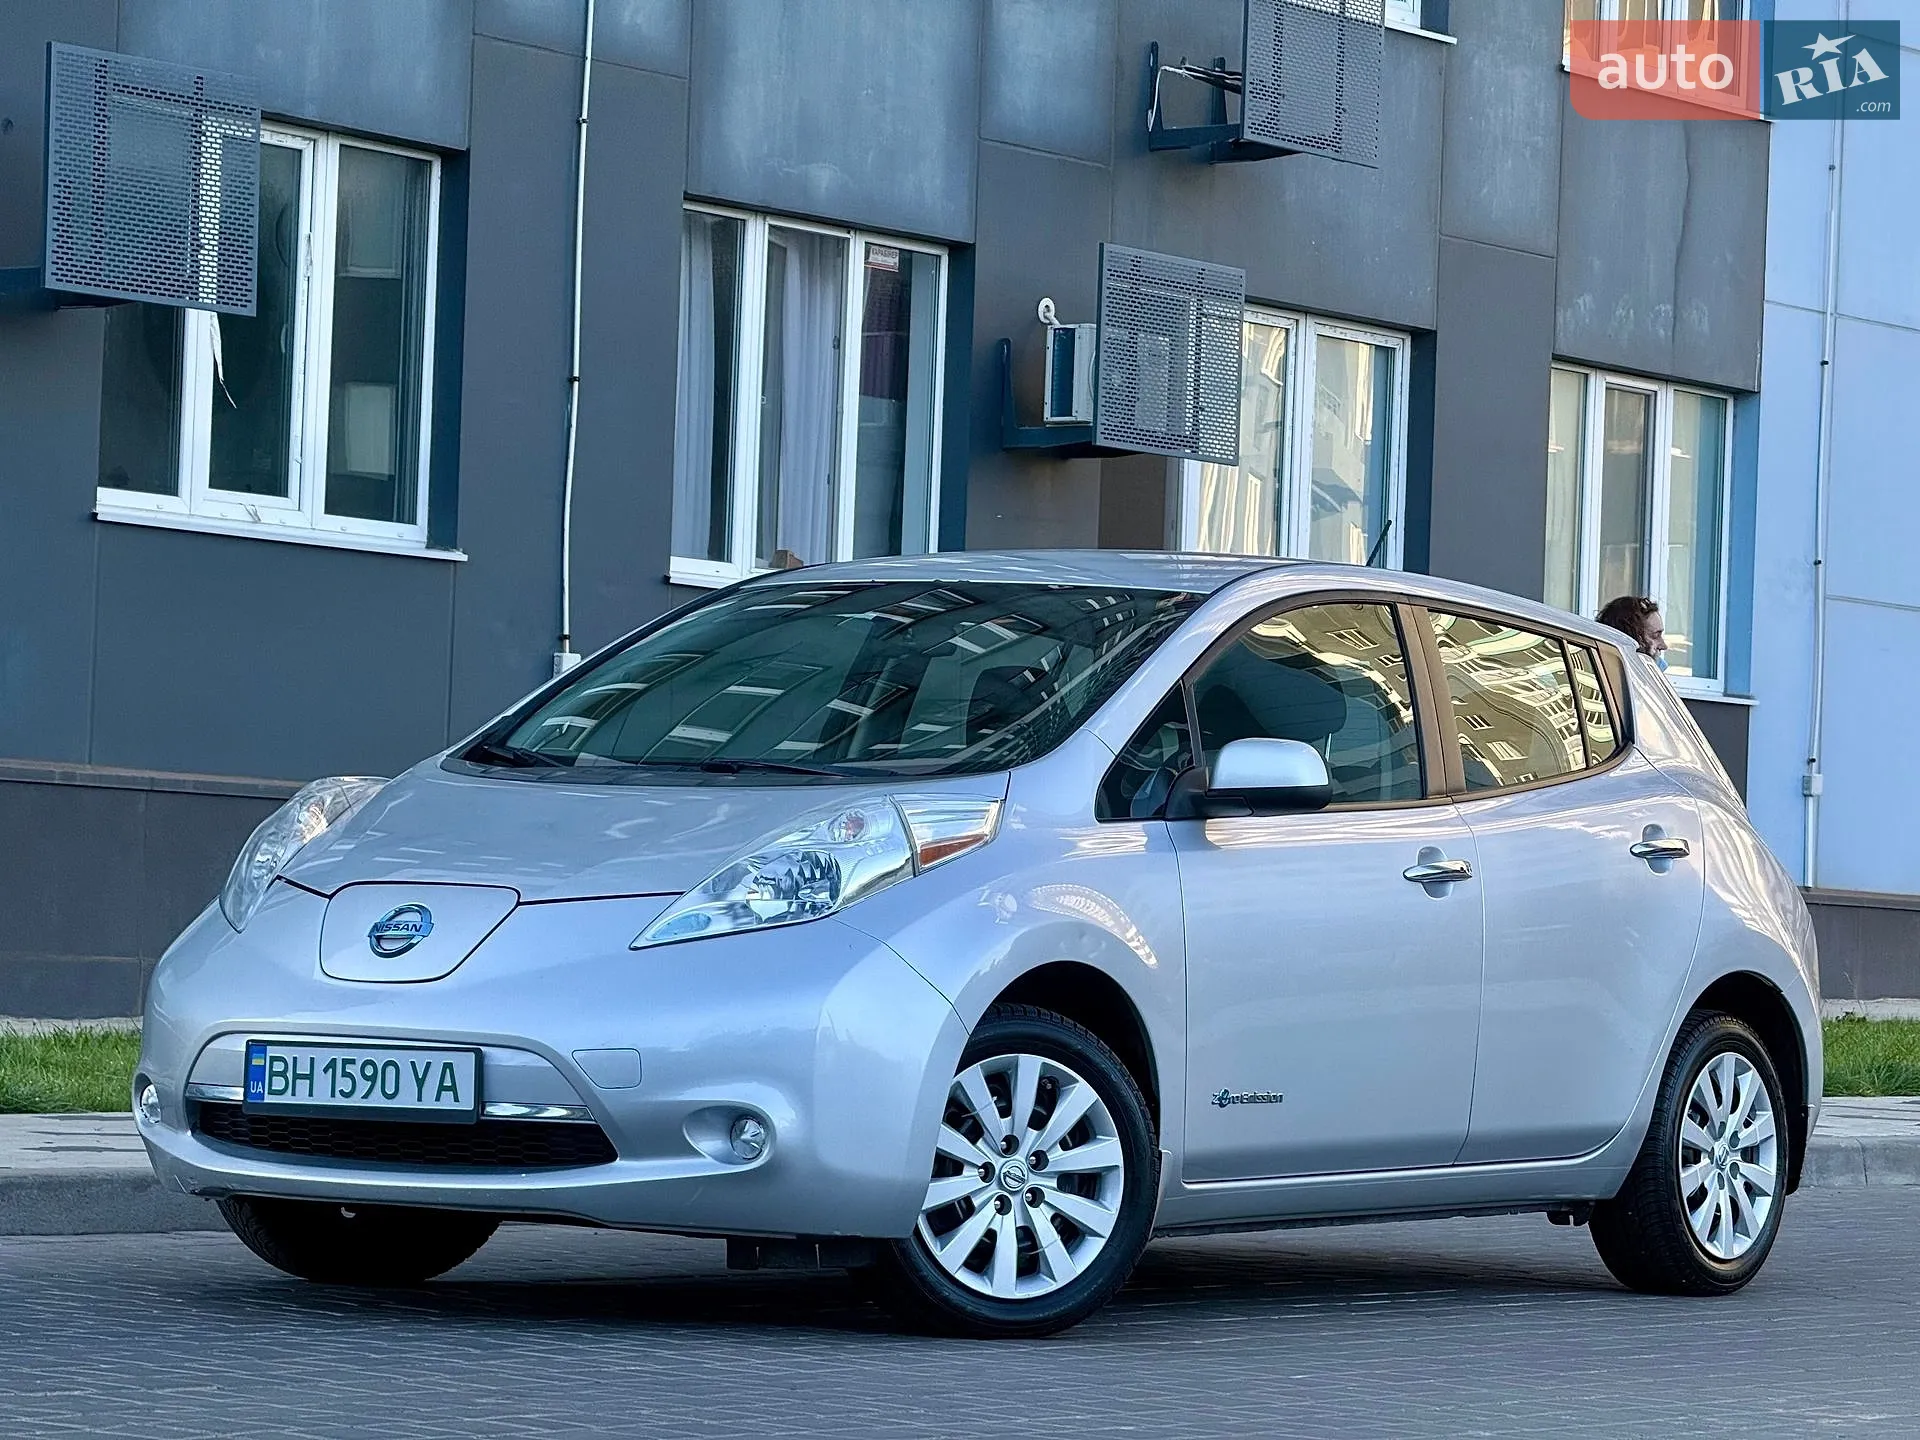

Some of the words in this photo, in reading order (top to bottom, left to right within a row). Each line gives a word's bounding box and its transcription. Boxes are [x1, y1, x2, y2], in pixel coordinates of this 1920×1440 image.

[374, 923, 423, 933] NISSAN
[267, 1055, 316, 1097] BH
[322, 1057, 401, 1101] 1590
[409, 1060, 461, 1103] YA
[249, 1081, 264, 1094] UA
